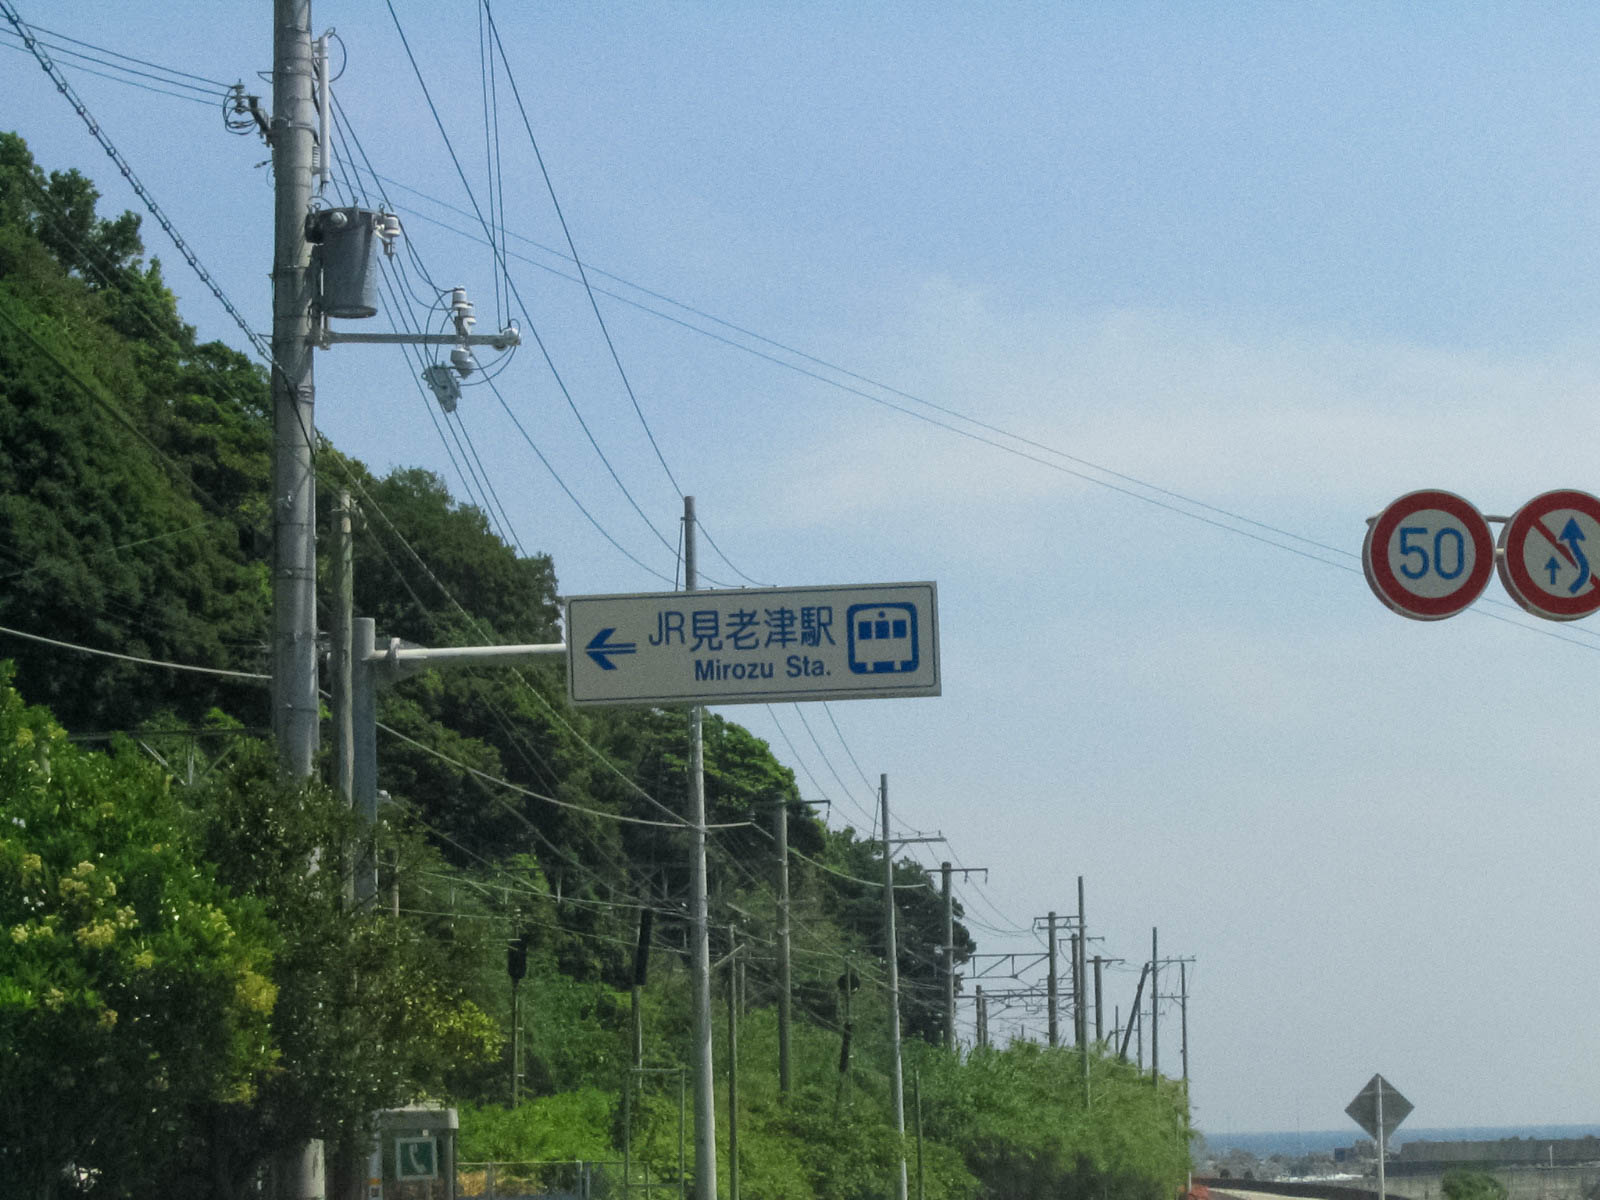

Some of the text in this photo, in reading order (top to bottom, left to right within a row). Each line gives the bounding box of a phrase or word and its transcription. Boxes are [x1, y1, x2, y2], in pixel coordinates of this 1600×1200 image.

[1400, 527, 1465, 580] 50
[649, 606, 837, 652] JR見老津駅
[695, 655, 832, 681] Mirozu Sta.
